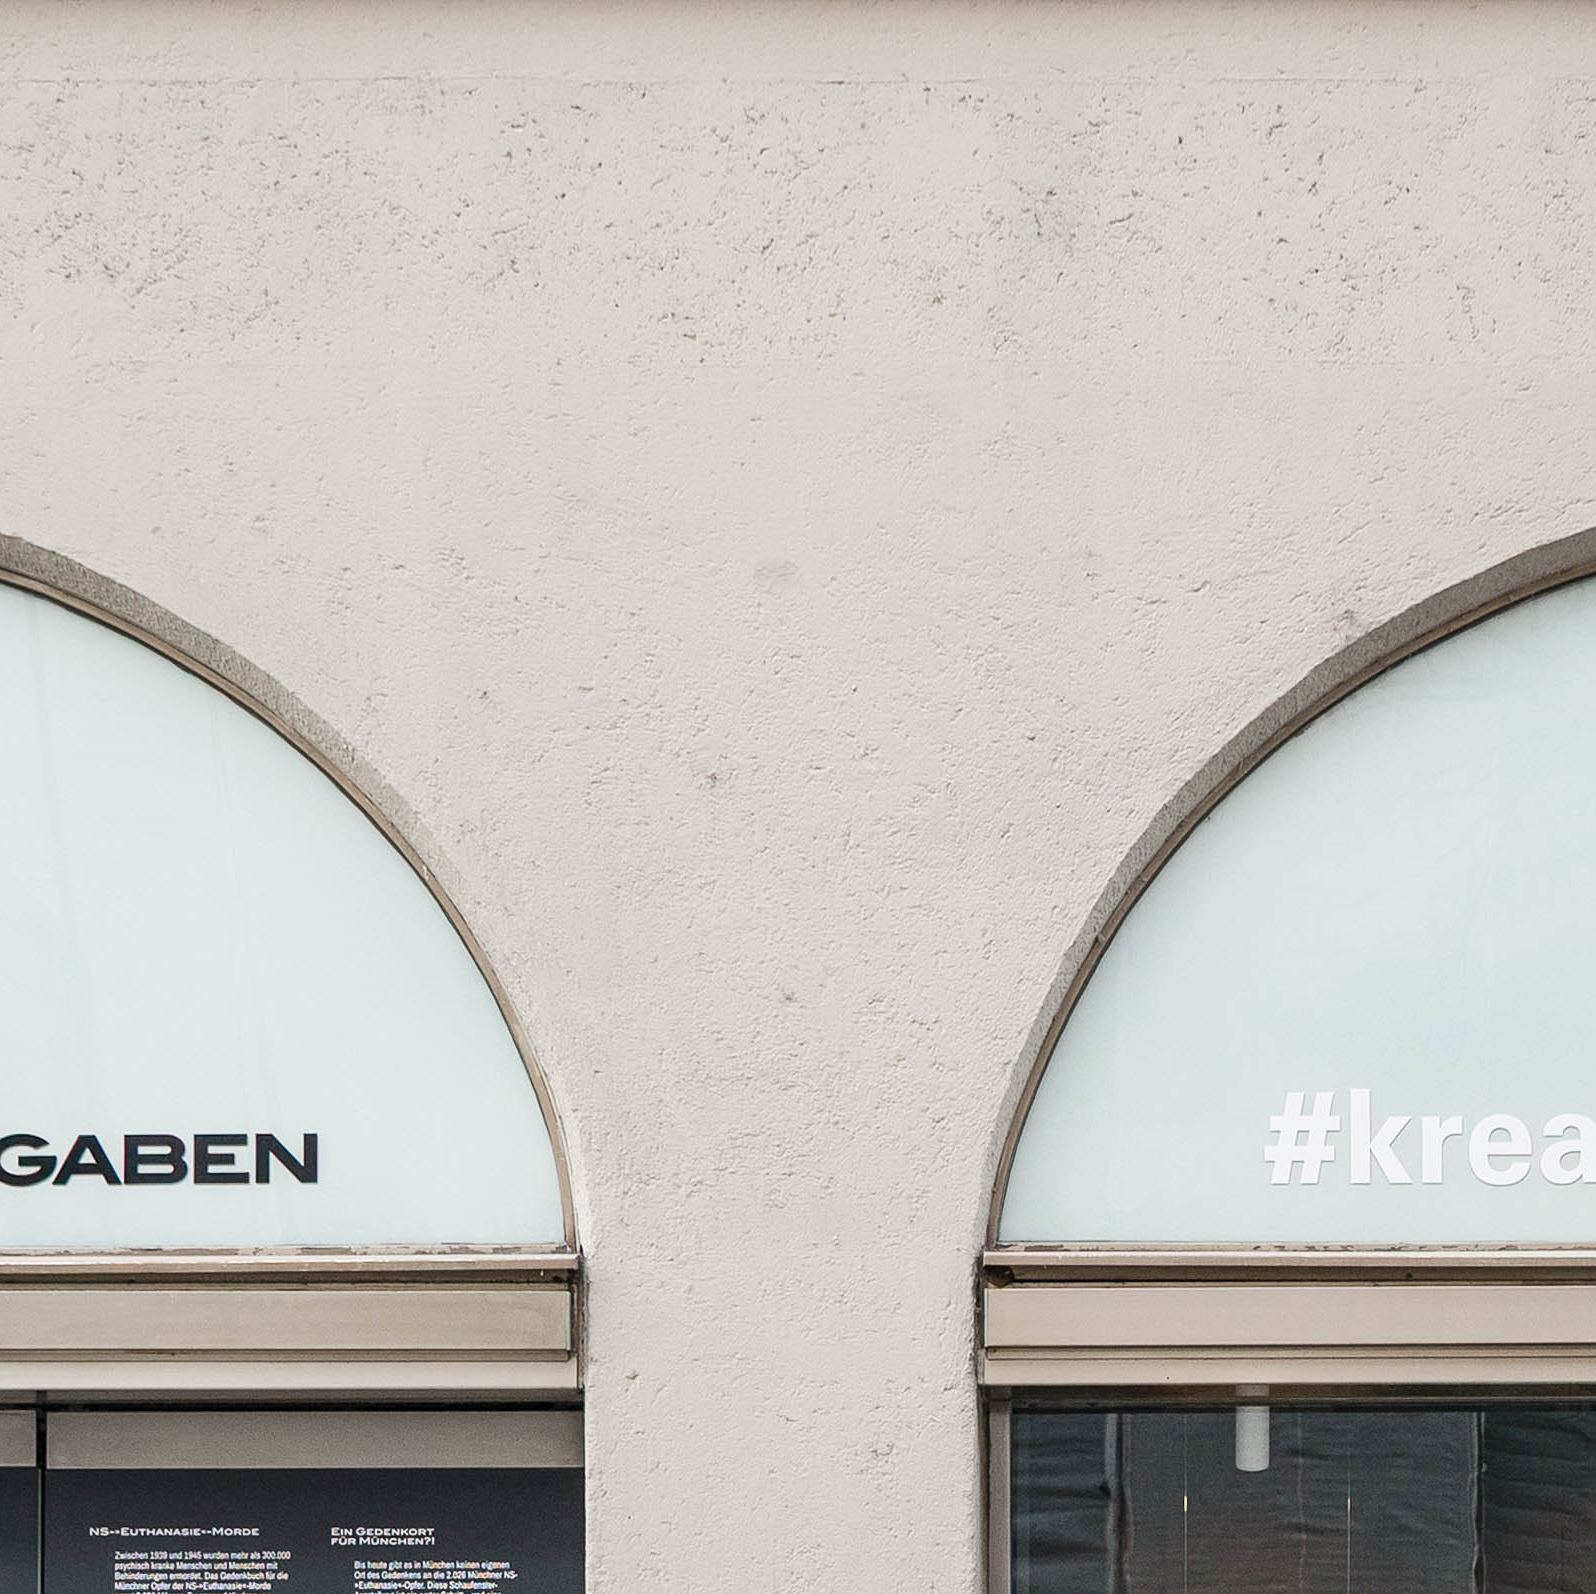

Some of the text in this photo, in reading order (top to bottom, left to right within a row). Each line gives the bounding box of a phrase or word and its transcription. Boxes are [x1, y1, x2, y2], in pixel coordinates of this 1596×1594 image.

[331, 1527, 435, 1536] EIN GEDENKORT
[330, 1536, 435, 1545] FÜR MÜNCHEN?!
[168, 1551, 183, 1559] und
[249, 1551, 261, 1559] als
[213, 1561, 227, 1570] und
[265, 1561, 278, 1570] mit
[353, 1560, 366, 1569] Bis
[413, 1560, 421, 1569] in
[203, 1571, 219, 1580] Das
[265, 1571, 275, 1580] für
[276, 1571, 289, 1580] die
[353, 1570, 365, 1579] Ort
[366, 1570, 380, 1579] des
[433, 1570, 445, 1579] die
